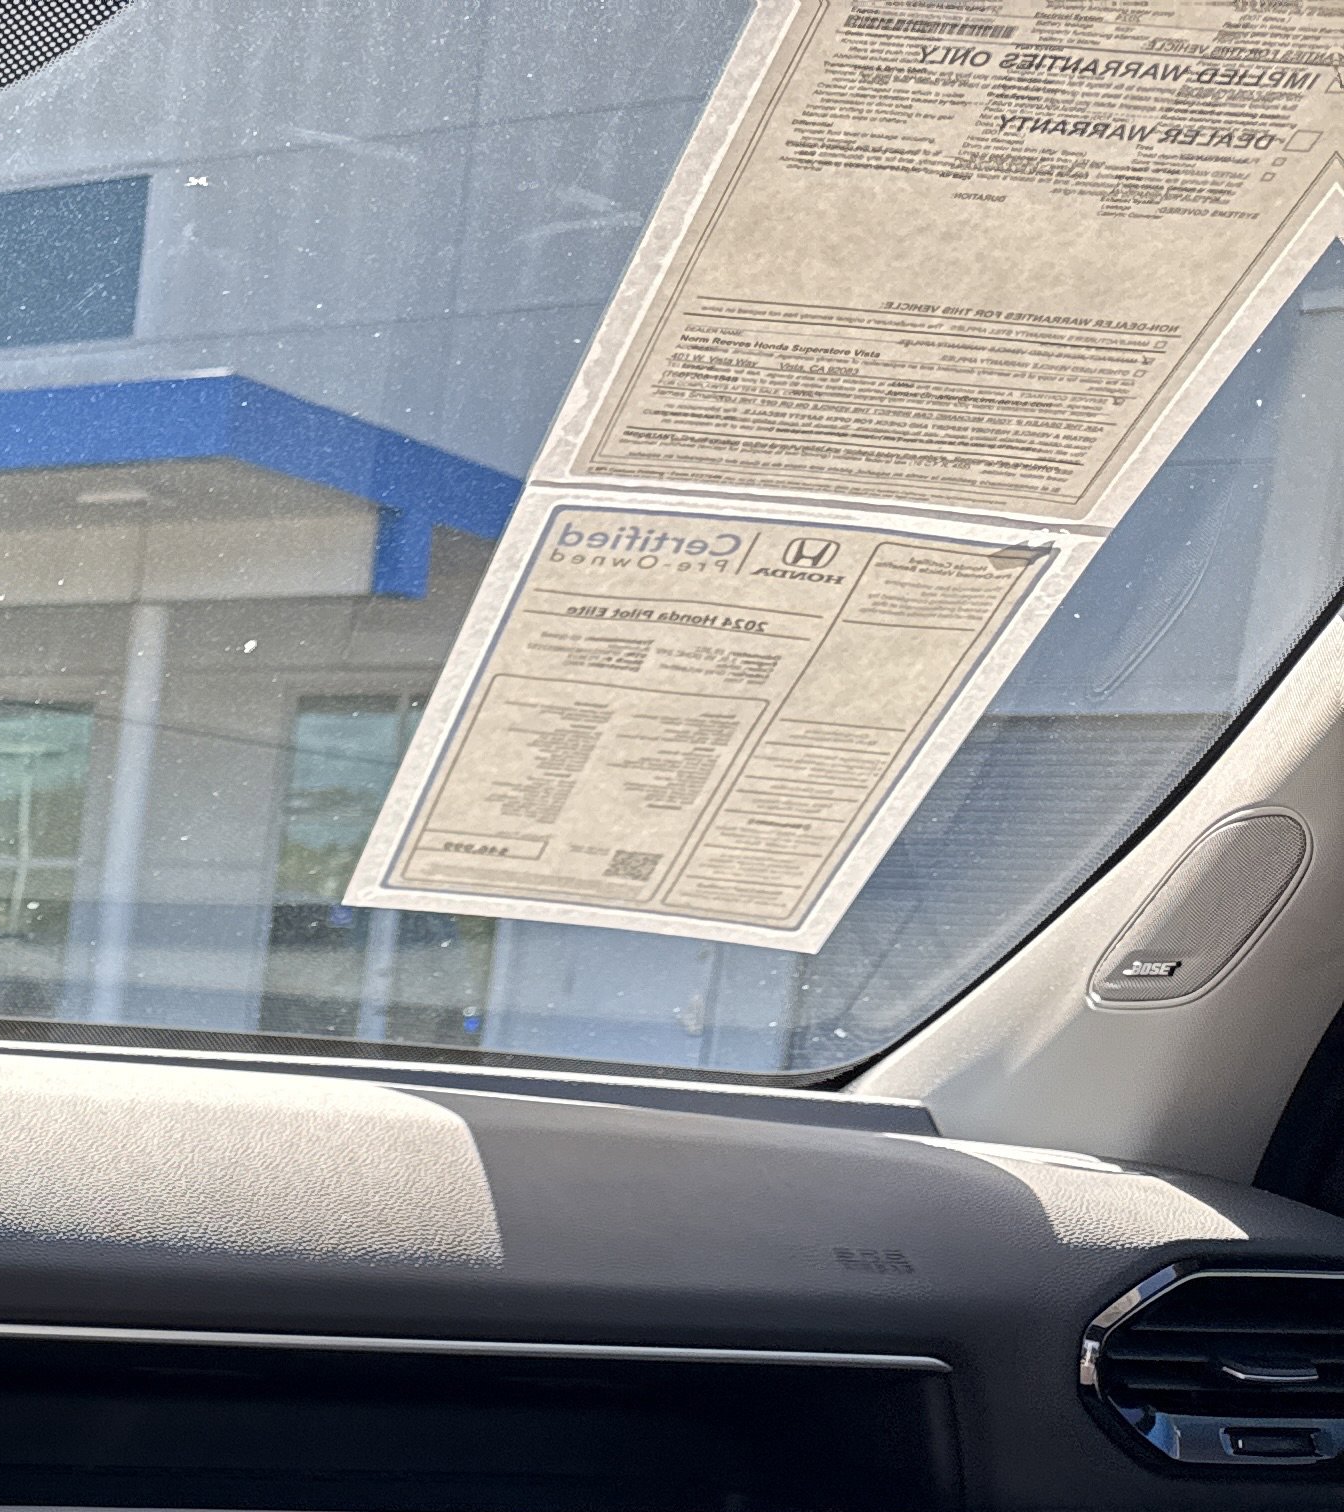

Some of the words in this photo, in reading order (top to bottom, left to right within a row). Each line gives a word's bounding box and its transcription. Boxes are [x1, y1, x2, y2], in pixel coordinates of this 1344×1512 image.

[680, 334, 709, 344] Norm
[713, 337, 751, 348] Reeves
[754, 341, 789, 352] Honda
[792, 344, 851, 357] Superstore
[854, 350, 881, 358] Vista
[1124, 960, 1180, 977] BOSE
